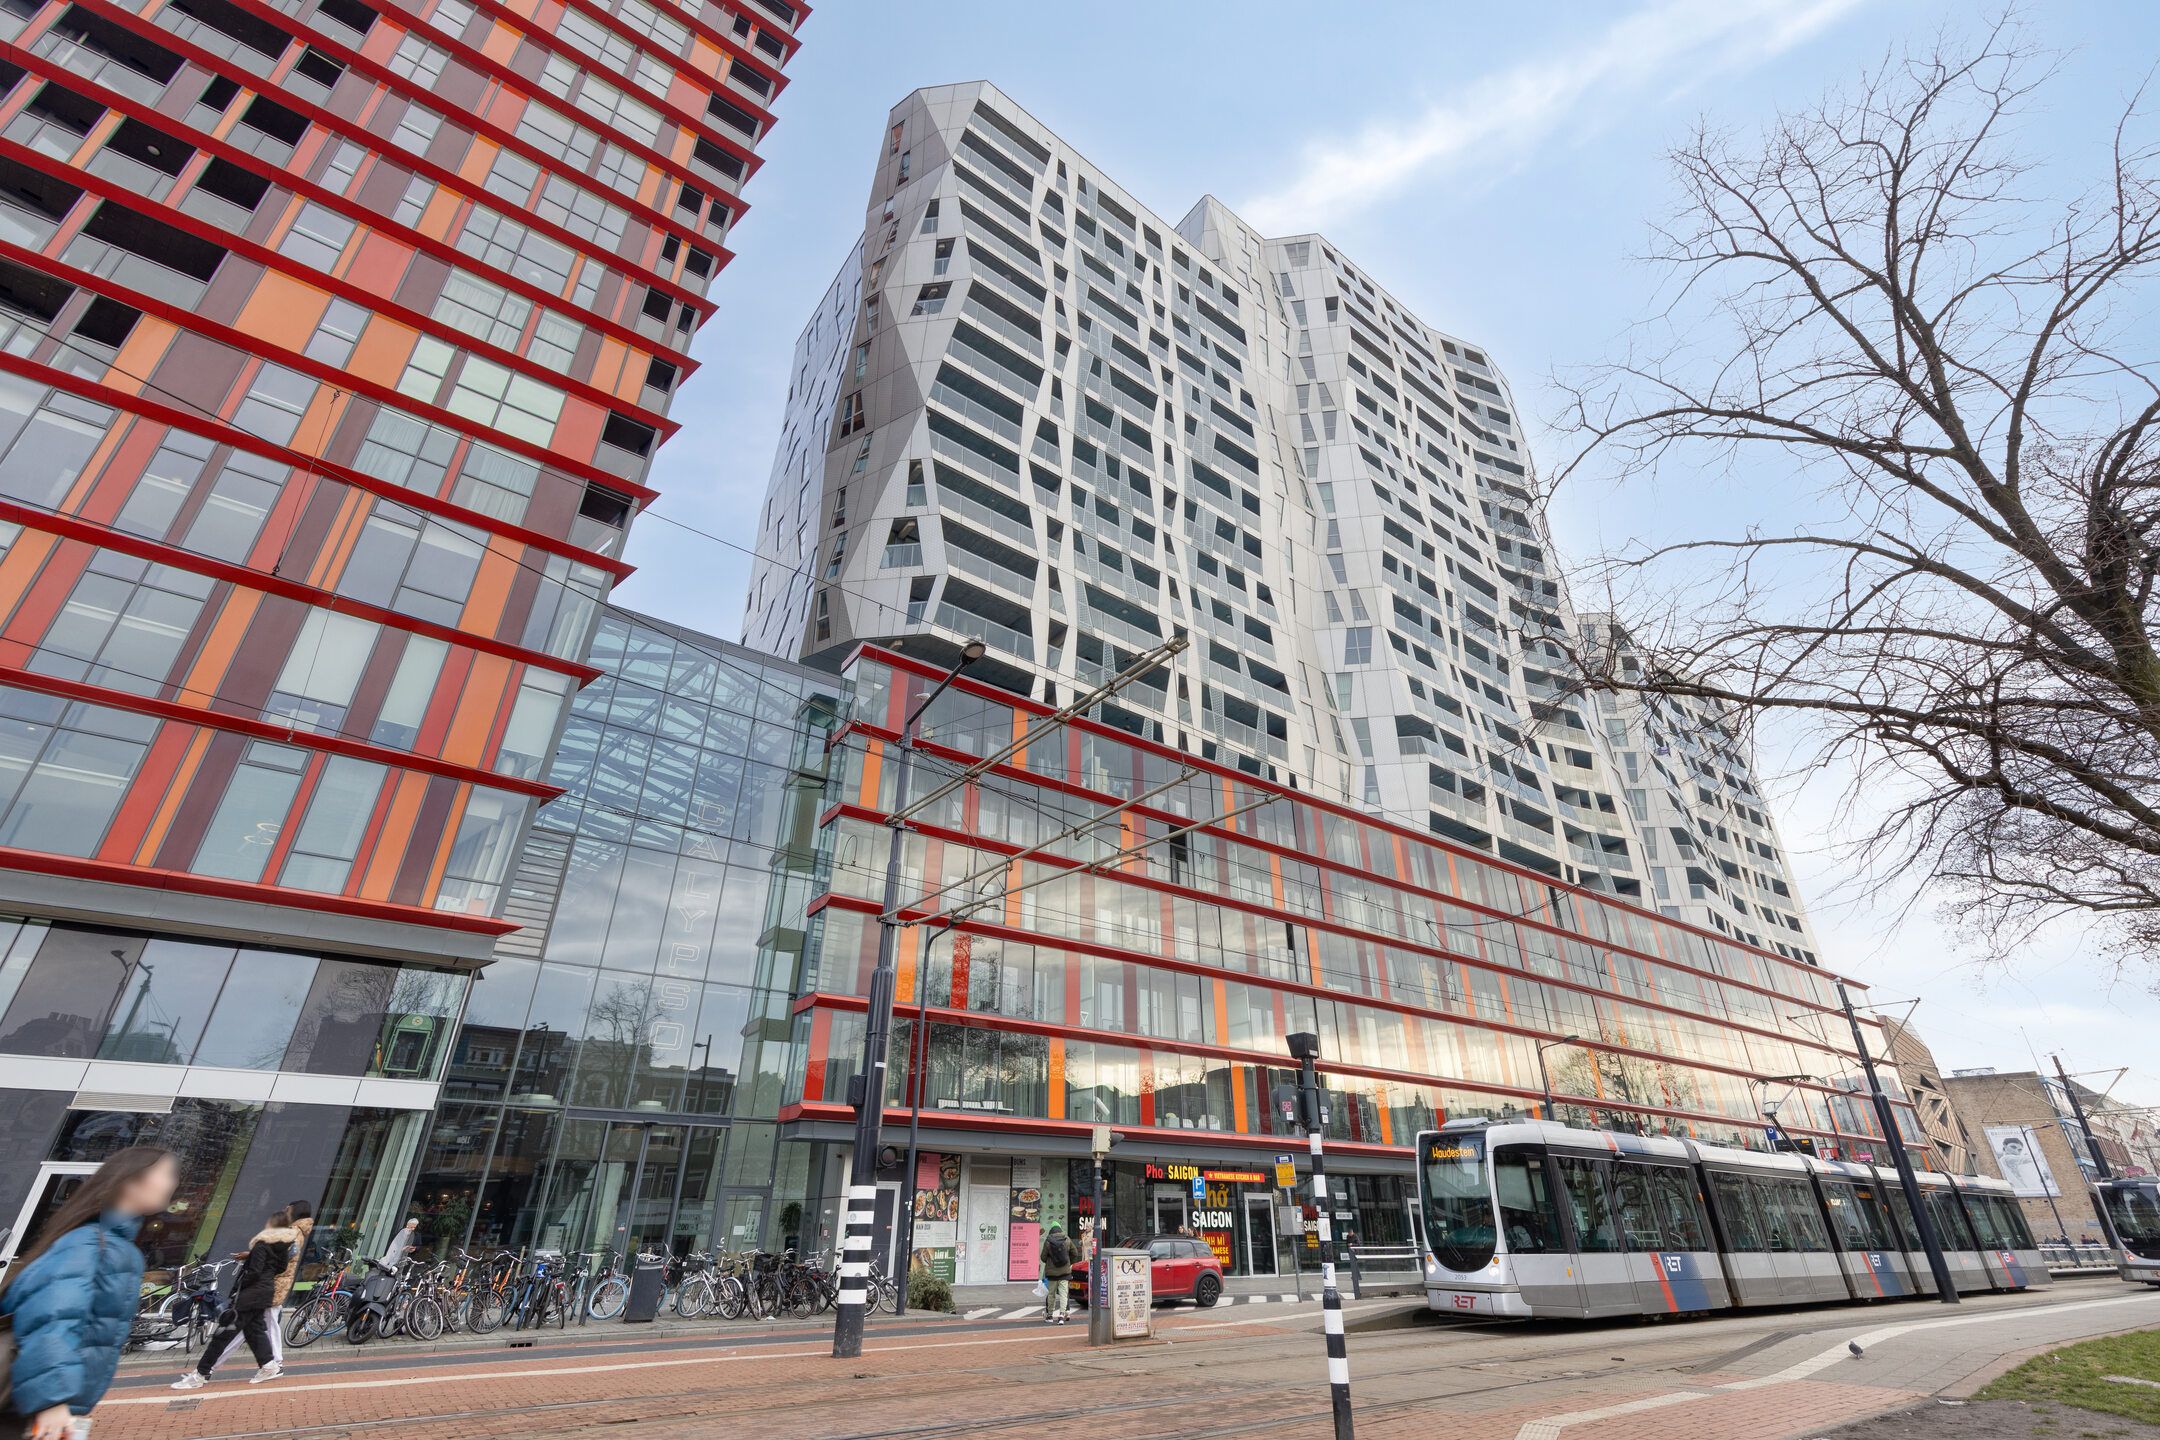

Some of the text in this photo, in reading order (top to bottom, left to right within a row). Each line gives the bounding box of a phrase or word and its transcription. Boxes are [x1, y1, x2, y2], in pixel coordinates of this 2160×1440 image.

[649, 801, 726, 1051] CALYPSO
[1168, 1165, 1199, 1180] SAIGON
[1195, 1178, 1202, 1189] P
[1192, 1211, 1233, 1228] SAIGON
[981, 1233, 996, 1241] SAIGON
[1665, 1256, 1681, 1271] RET
[1870, 1254, 1882, 1266] RET
[1452, 1295, 1476, 1309] RET
